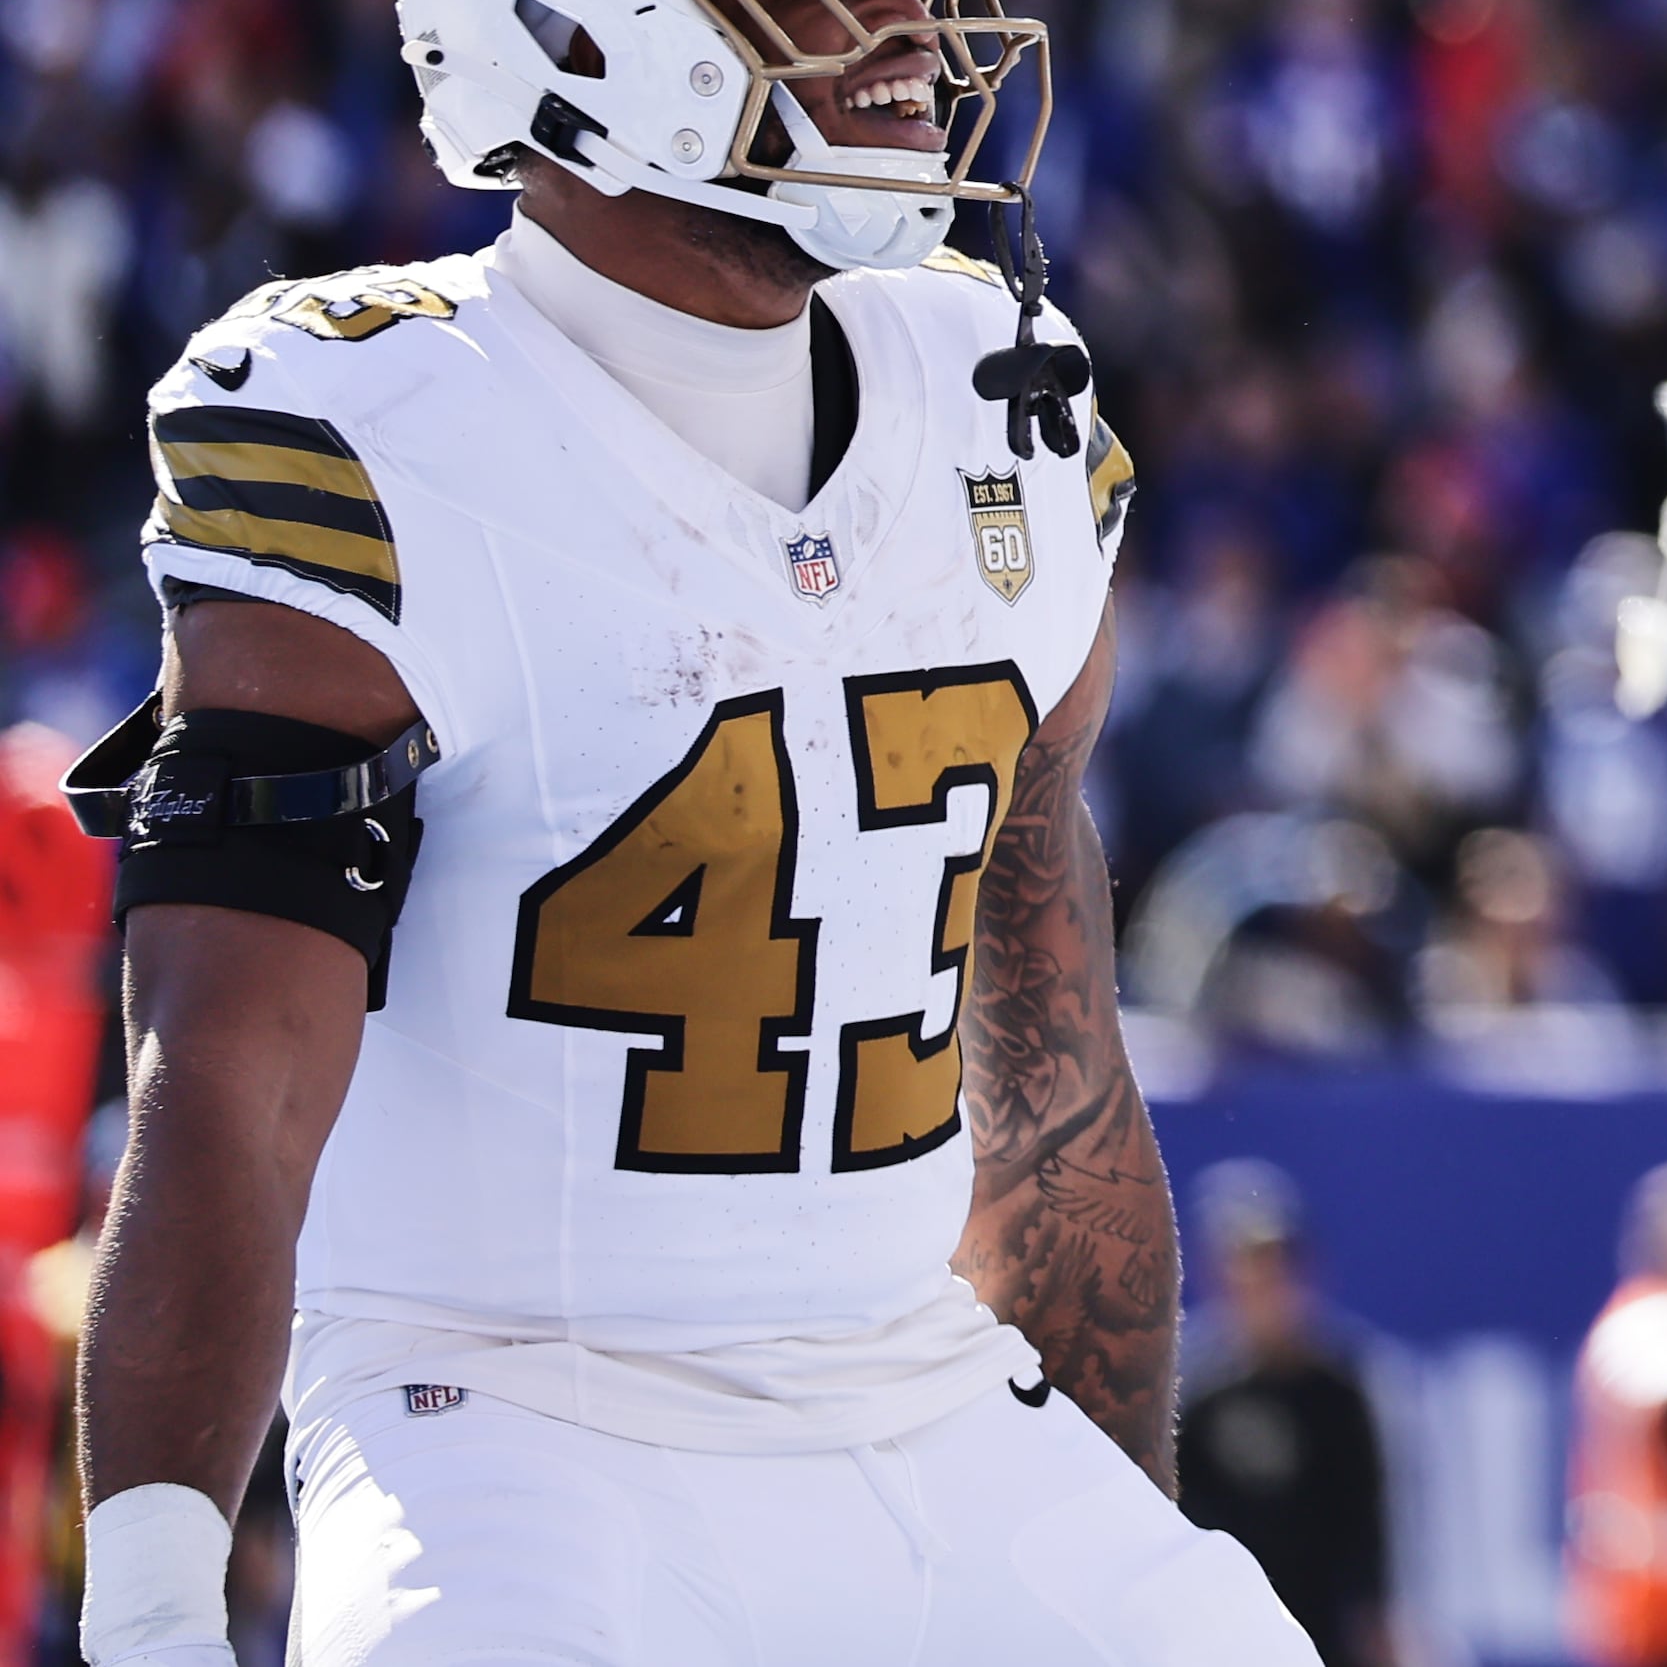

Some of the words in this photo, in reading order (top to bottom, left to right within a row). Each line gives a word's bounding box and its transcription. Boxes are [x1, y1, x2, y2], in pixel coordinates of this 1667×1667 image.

[972, 484, 993, 504] EST.
[980, 525, 1028, 573] 60
[795, 560, 836, 592] NFL
[506, 659, 1039, 1175] 43
[413, 1386, 458, 1410] NFL
